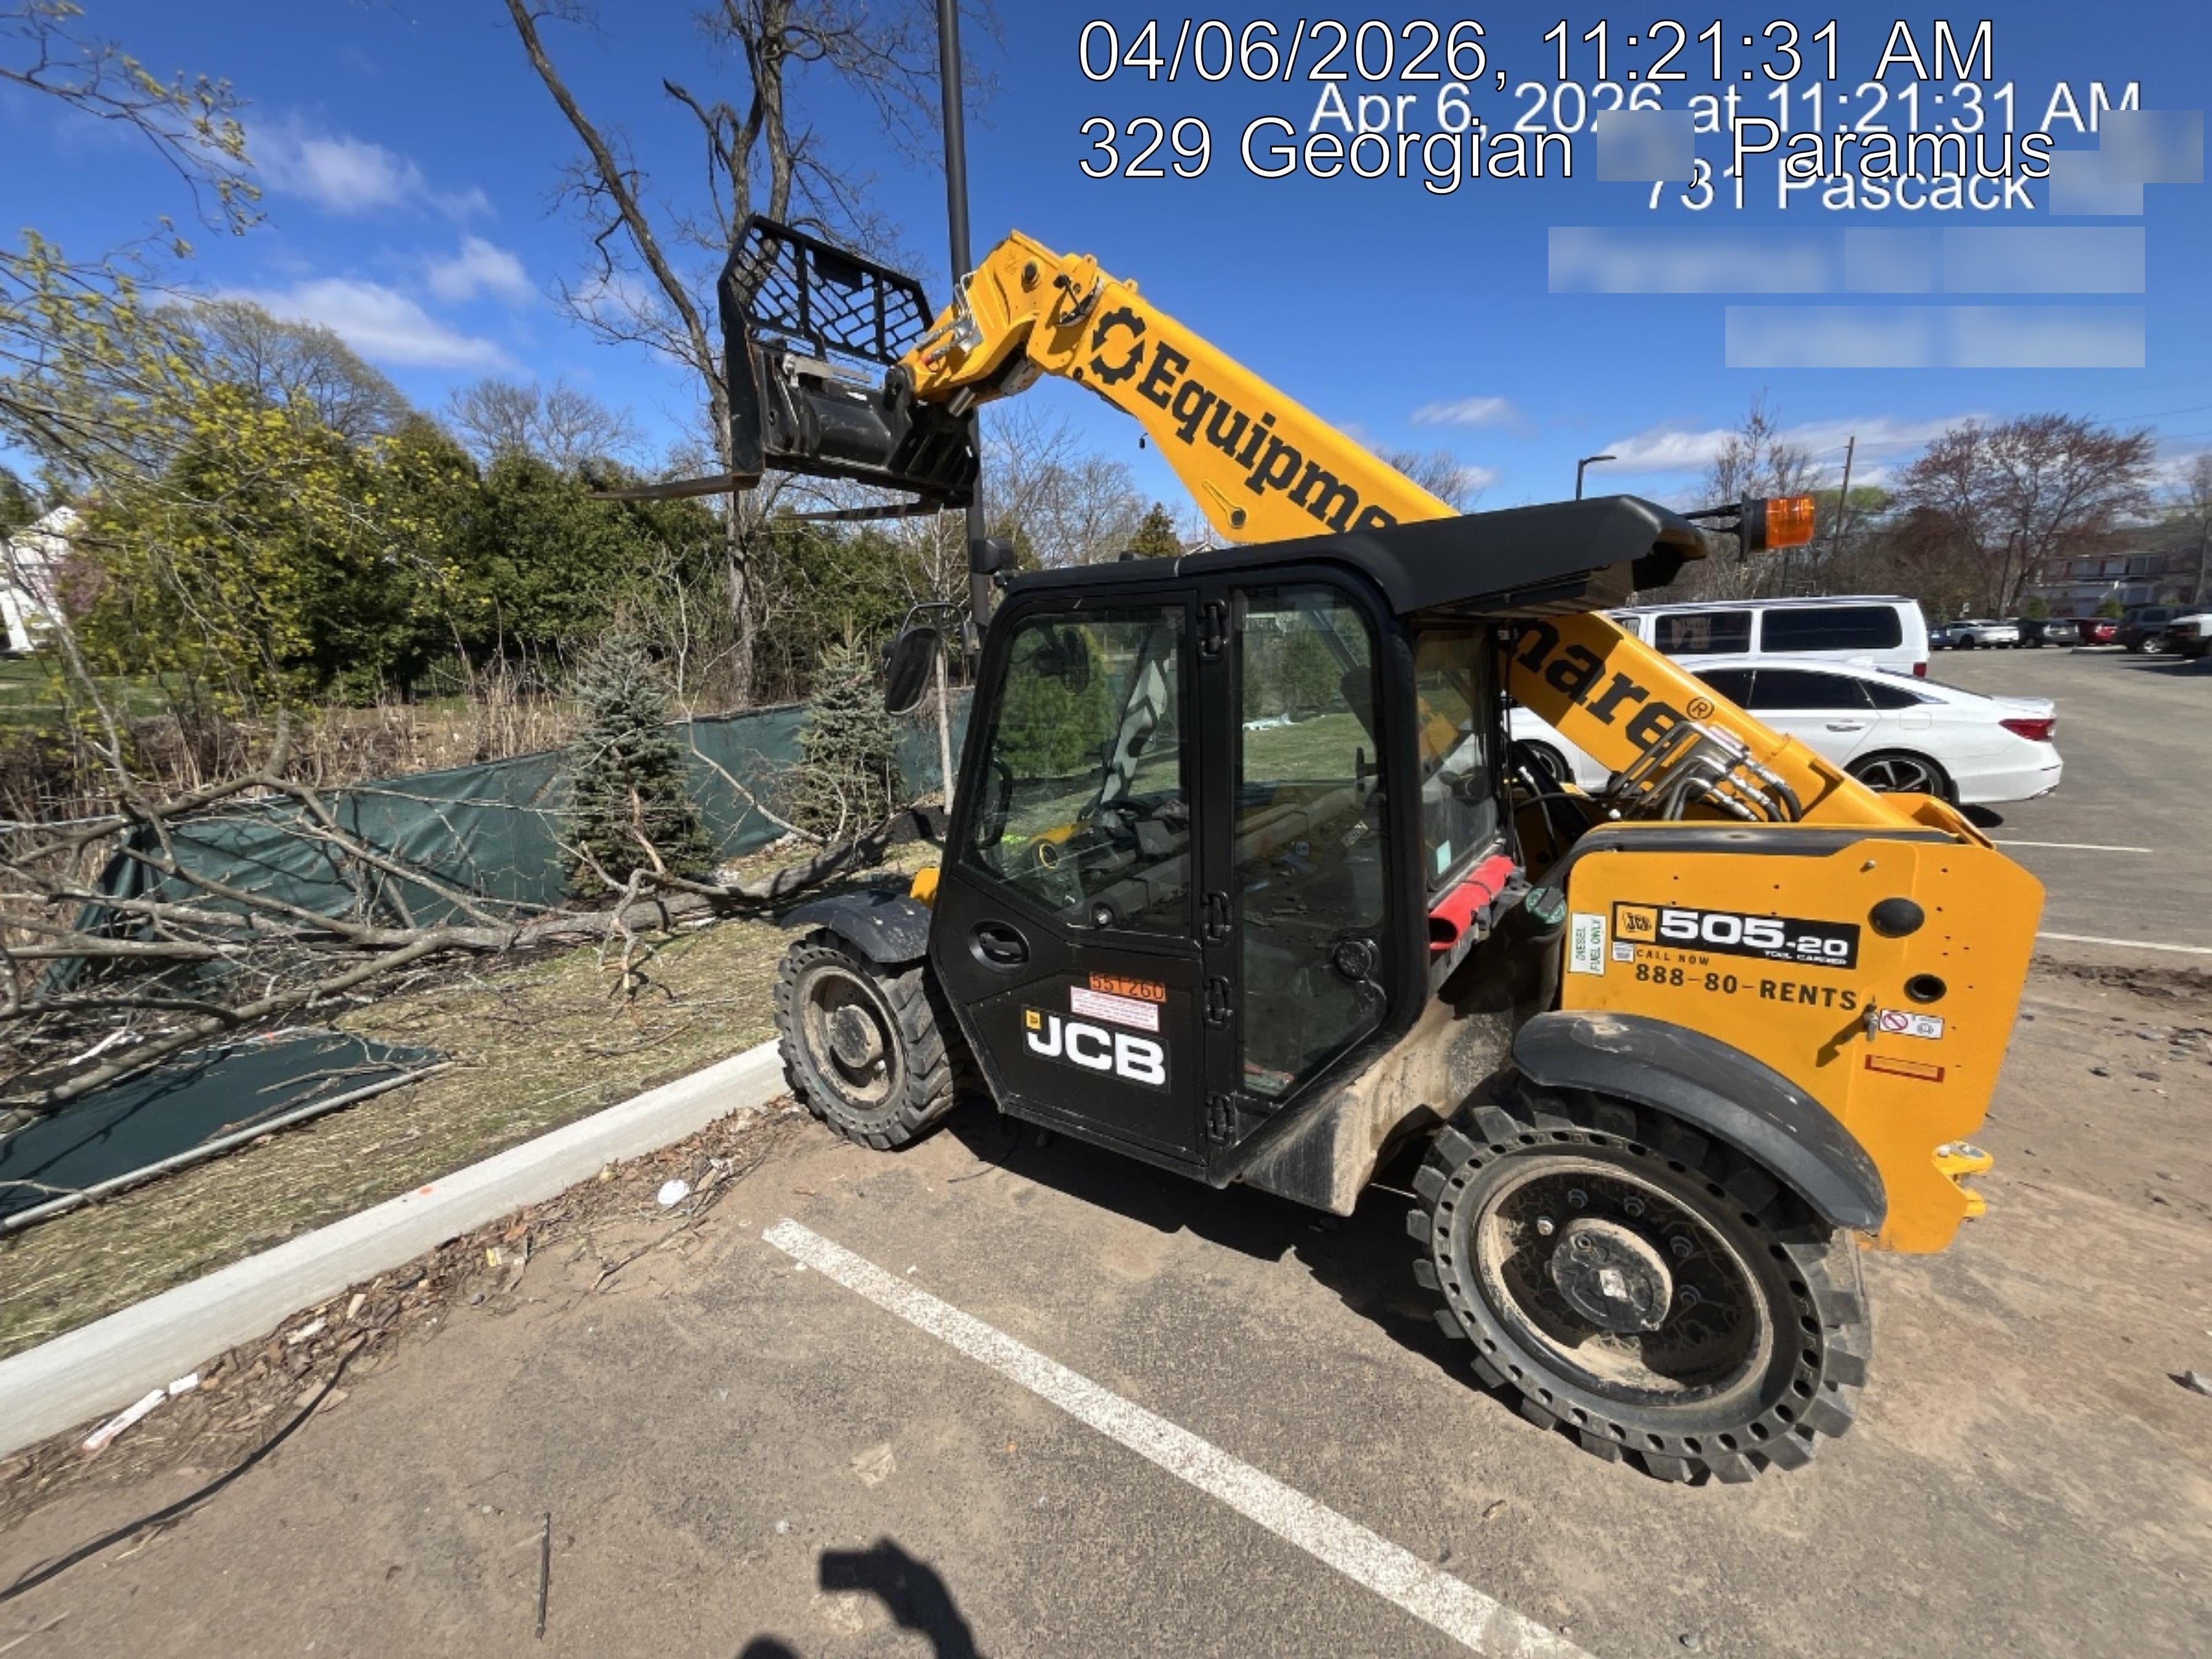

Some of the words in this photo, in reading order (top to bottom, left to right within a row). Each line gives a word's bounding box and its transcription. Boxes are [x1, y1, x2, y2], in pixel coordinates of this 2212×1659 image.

[1575, 927, 1586, 961] DIESEL
[1590, 917, 1601, 944] ONLY
[1660, 908, 1849, 957] 505-20
[1590, 947, 1601, 972] FUEL
[1636, 949, 1671, 961] CALL
[1678, 954, 1709, 966] NOW
[1636, 963, 1857, 1011] 888-80-RENTS
[1026, 1015, 1166, 1085] JCB
